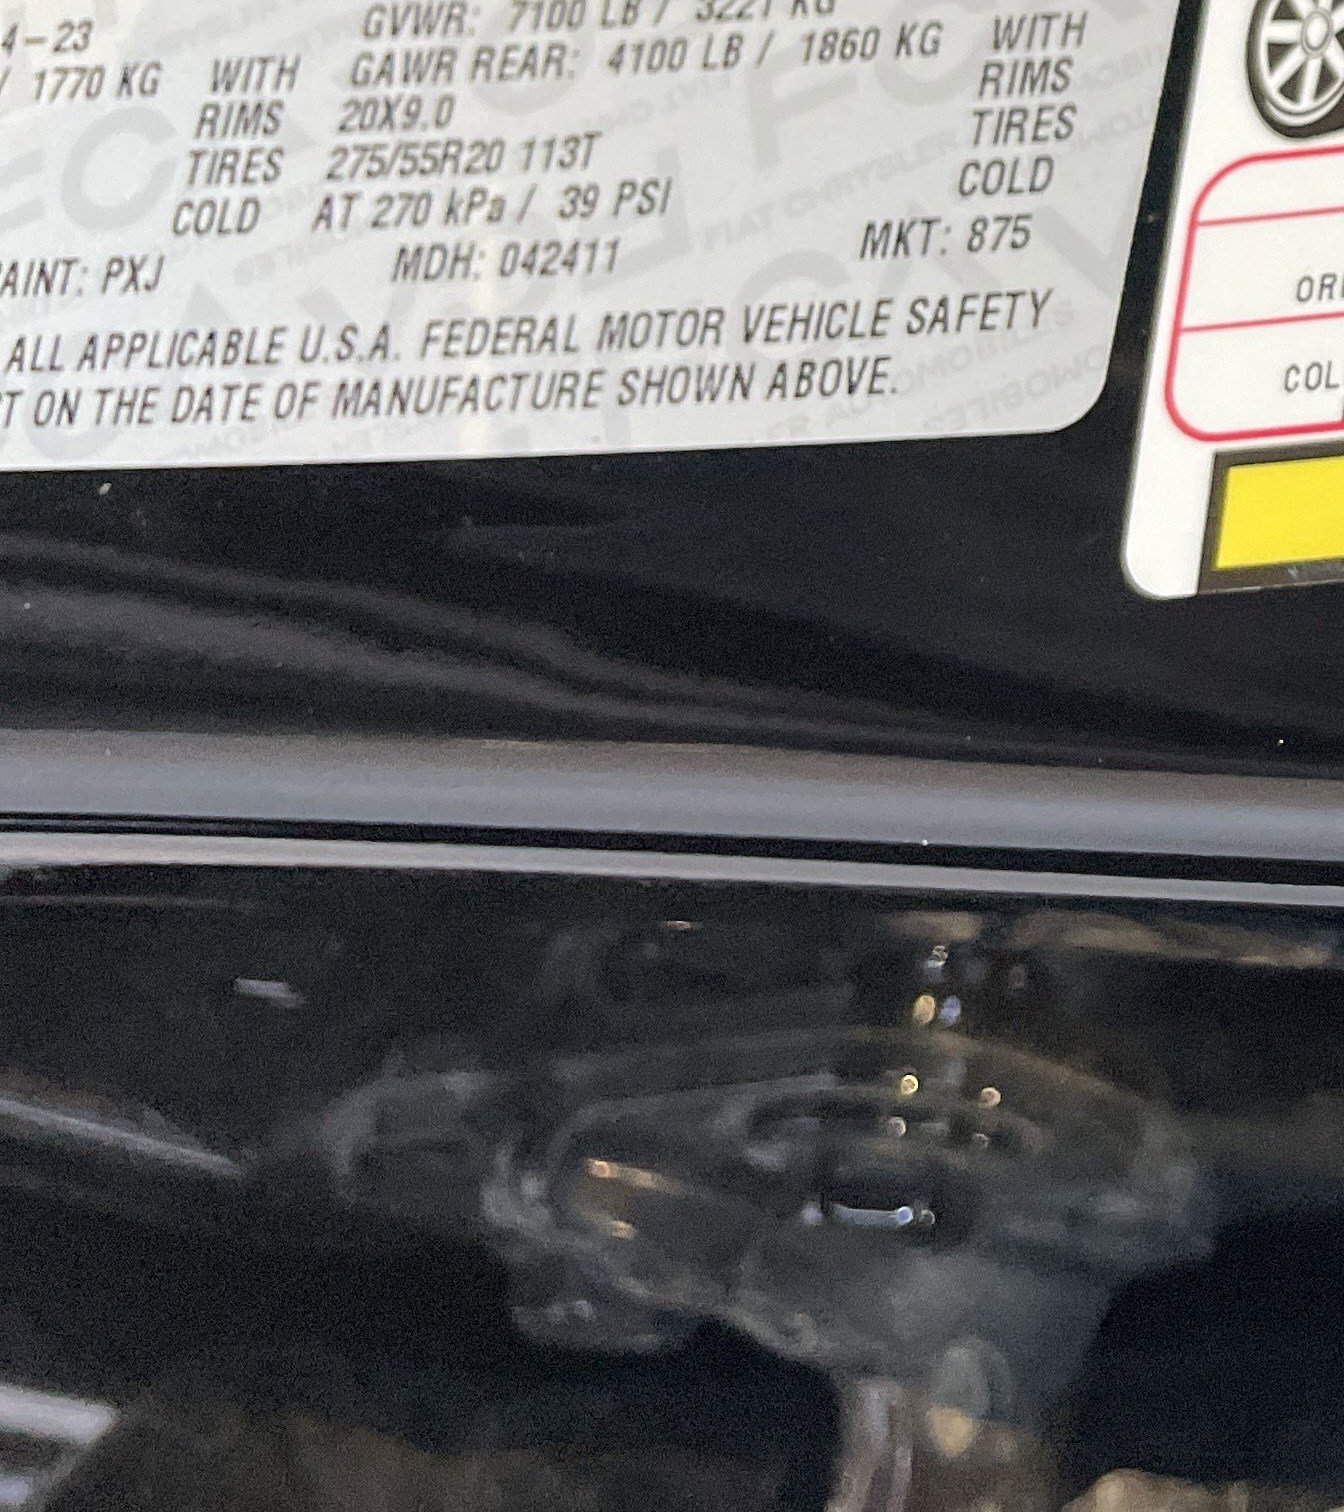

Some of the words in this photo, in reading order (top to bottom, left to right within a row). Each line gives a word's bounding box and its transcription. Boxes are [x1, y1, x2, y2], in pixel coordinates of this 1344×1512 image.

[363, 1, 480, 39] GVWR:
[992, 11, 1089, 52] WITH
[210, 55, 300, 94] WITH
[350, 52, 458, 89] GAWR
[473, 44, 580, 83] REAR:
[607, 40, 689, 74] 4100
[702, 36, 743, 70] LB
[755, 30, 775, 65] /
[800, 28, 880, 64] 1860
[895, 21, 944, 58] KG
[33, 66, 104, 102] 1770
[115, 60, 162, 100] KG
[977, 58, 1073, 98] RIMS
[195, 100, 284, 140] RIMS
[338, 95, 455, 134] 20X9.0
[971, 103, 1077, 148] TIRES
[187, 146, 286, 186] TIRES
[326, 141, 502, 180] 275/55R20
[520, 131, 602, 173] 113T
[957, 156, 1055, 198] COLD
[172, 196, 260, 237] COLD
[311, 192, 362, 232] AT
[371, 189, 432, 230] 270
[442, 185, 502, 226] kPa
[515, 186, 533, 221] /
[558, 183, 598, 223] 39
[612, 177, 671, 218] PSI
[859, 218, 952, 262] MKT:
[966, 213, 1032, 254] 875
[0, 256, 88, 297] AINT:
[103, 255, 165, 295] PXJ
[392, 244, 485, 284] MDH:
[500, 238, 620, 278] 042411
[7, 333, 65, 374] ALL
[77, 326, 287, 371] APPLICABLE
[300, 322, 400, 365] U.S.A.
[420, 313, 578, 361] FEDERAL
[600, 307, 726, 350] MOTOR
[743, 298, 893, 345] VEHICLE
[906, 288, 1053, 335] SAFETY
[0, 389, 24, 430] T
[33, 391, 80, 428] ON
[95, 388, 157, 426] THE
[170, 384, 262, 425] DATE
[273, 381, 321, 420] OF
[332, 368, 605, 419] MANUFACTURE
[617, 364, 756, 407] SHOWN
[767, 356, 898, 397] ABOVE.
